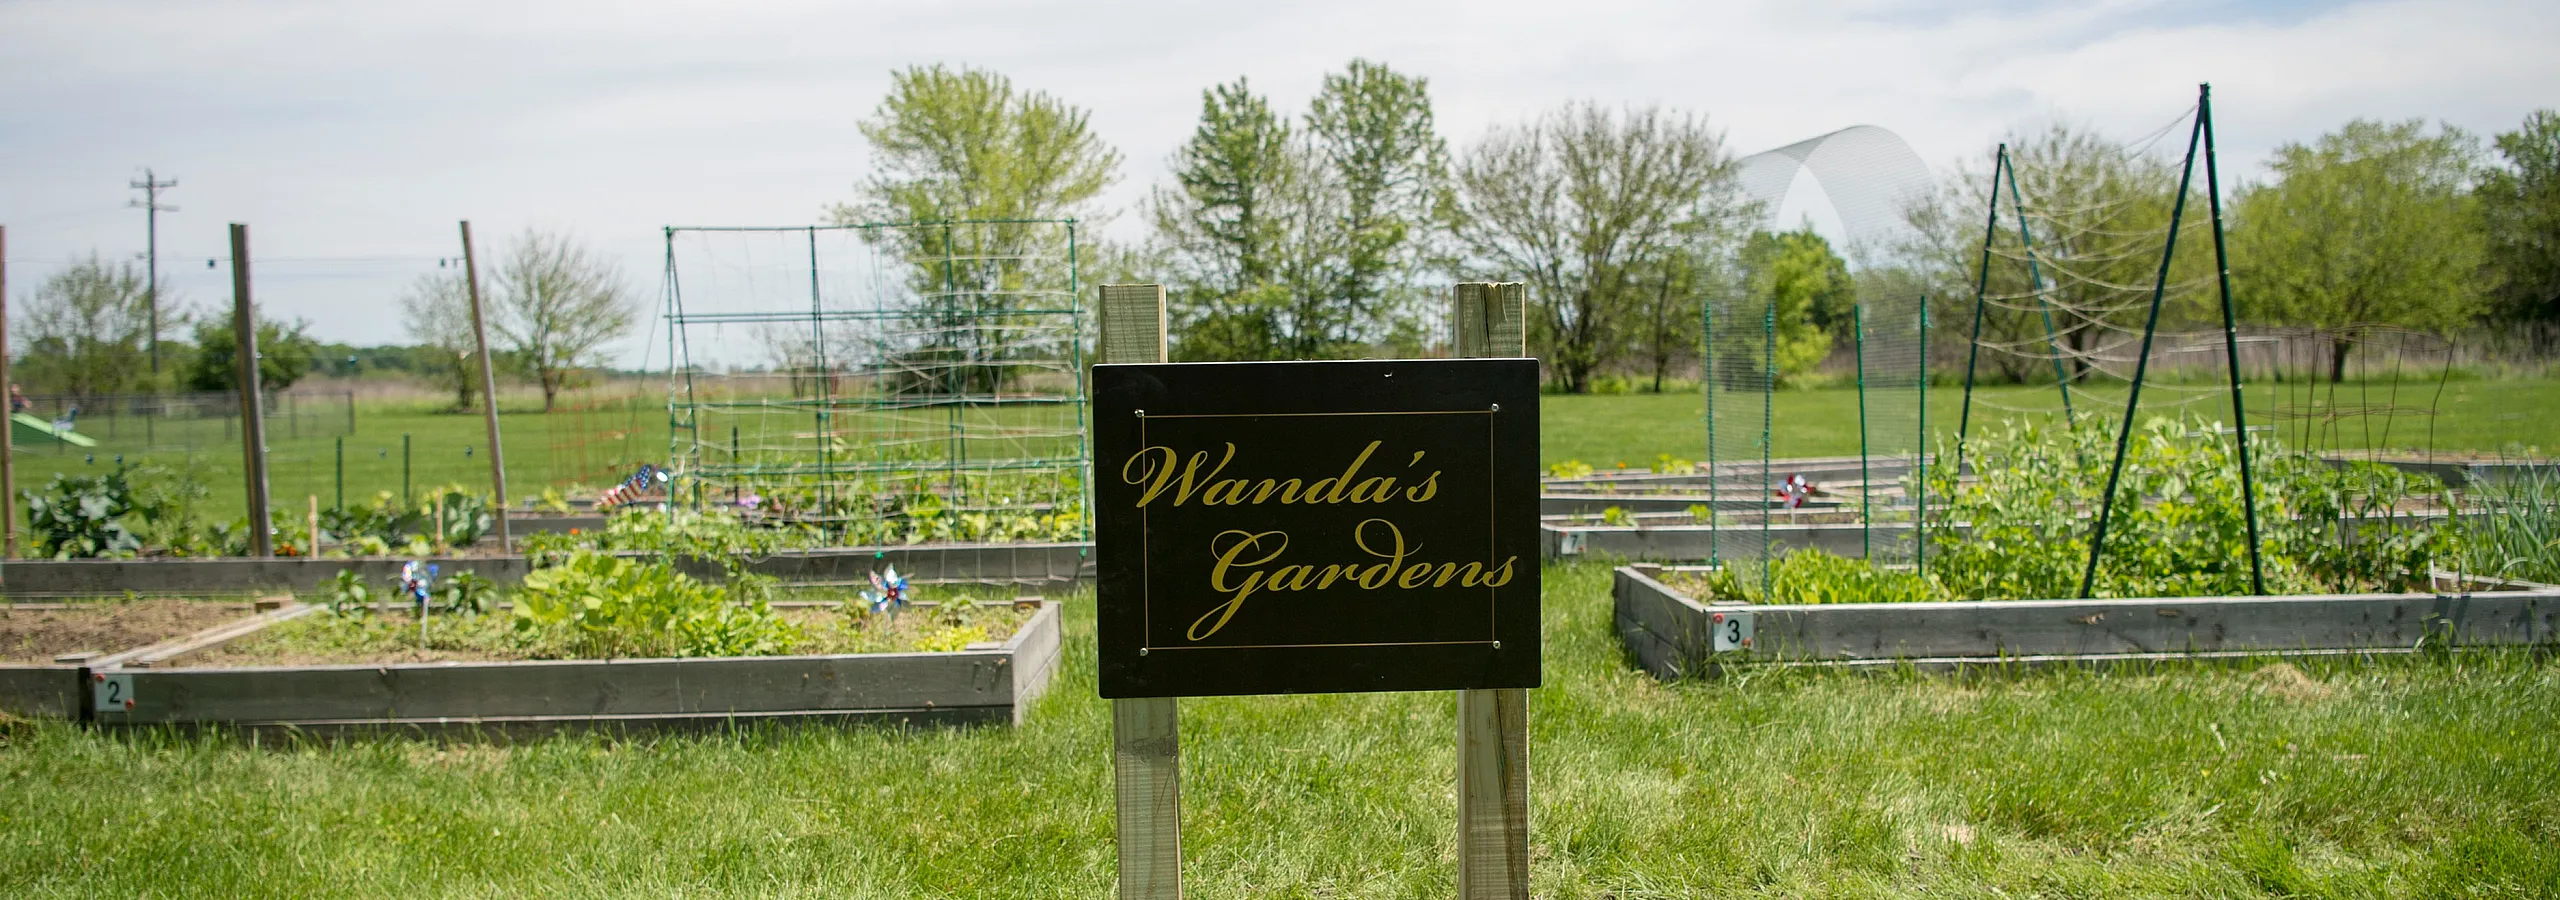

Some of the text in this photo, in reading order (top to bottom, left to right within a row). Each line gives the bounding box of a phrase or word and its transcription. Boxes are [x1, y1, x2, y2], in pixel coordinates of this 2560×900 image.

[1122, 440, 1442, 508] Wanda's
[1186, 518, 1518, 642] Gardens
[1727, 619, 1740, 643] 3
[107, 681, 121, 704] 2
